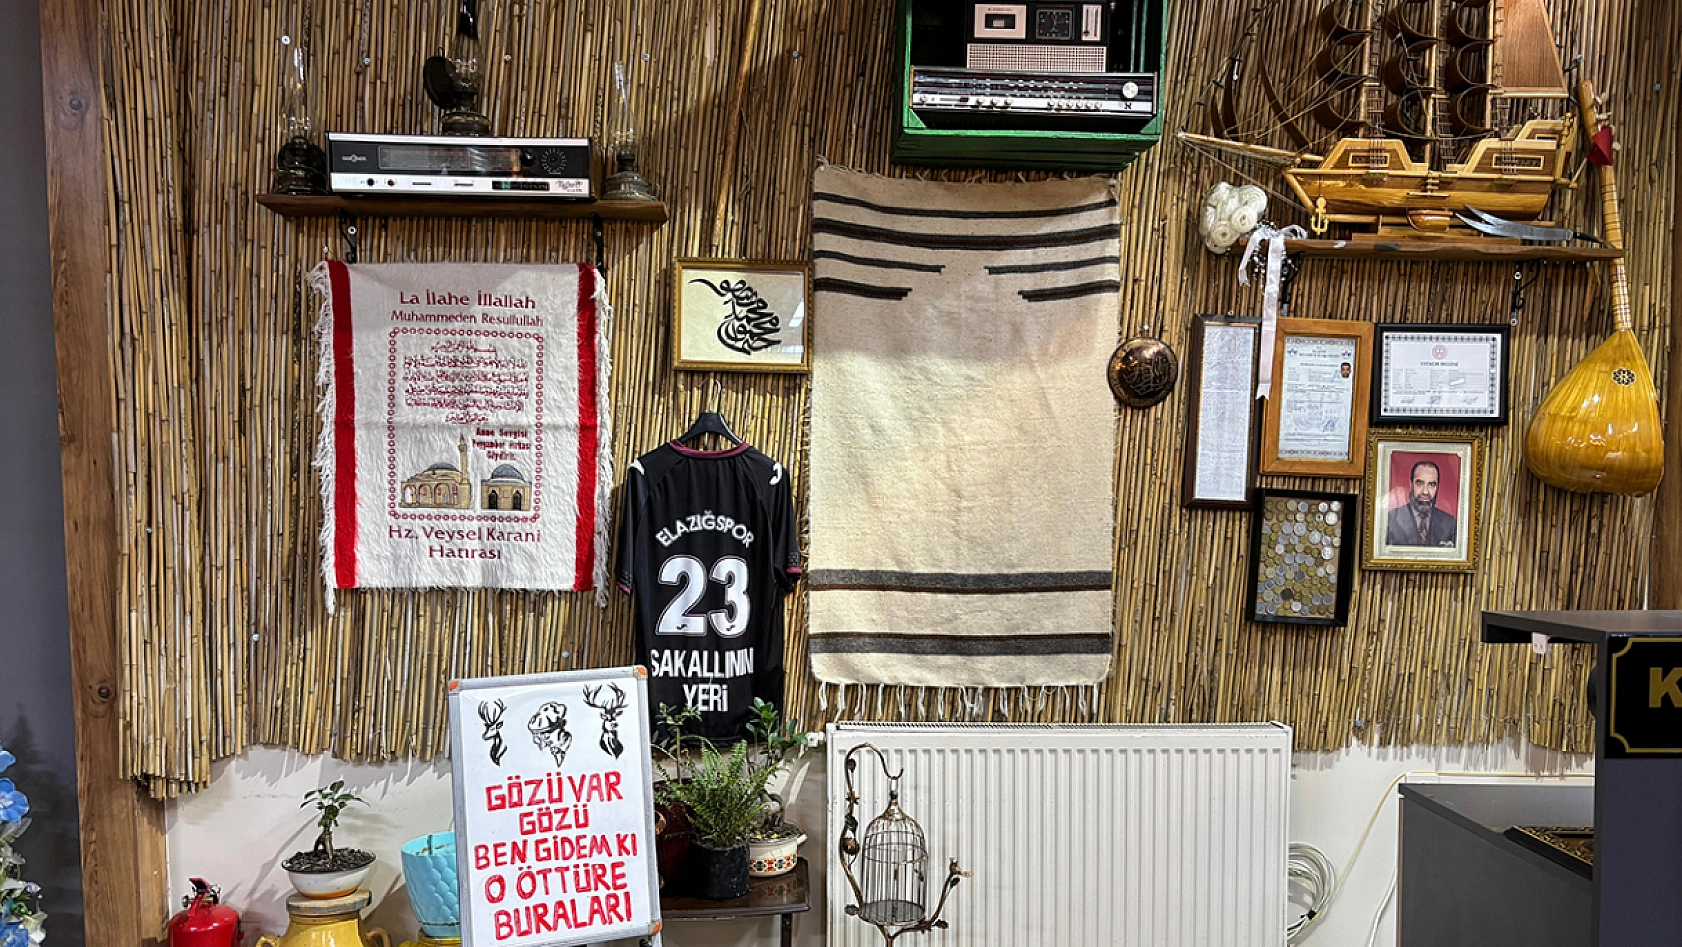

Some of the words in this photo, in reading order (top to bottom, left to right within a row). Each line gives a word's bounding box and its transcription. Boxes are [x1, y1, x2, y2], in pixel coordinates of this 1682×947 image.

[400, 291, 421, 305] La
[426, 289, 471, 306] İlahe
[390, 310, 477, 324] Muhammeden
[388, 526, 419, 539] Hz.
[422, 526, 482, 543] Veysel
[486, 526, 541, 543] Karani
[655, 509, 755, 549] ELAZIĞSPOR
[655, 555, 750, 638] 23
[485, 772, 564, 812] GÖZÜ
[567, 771, 624, 803] VAR
[519, 804, 590, 836] GÖZÜ
[474, 838, 528, 870] BEN
[535, 834, 613, 862] GİDEM
[485, 874, 507, 904] O
[516, 861, 628, 900] ÖTTÜRE
[494, 891, 632, 941] BURALARI
